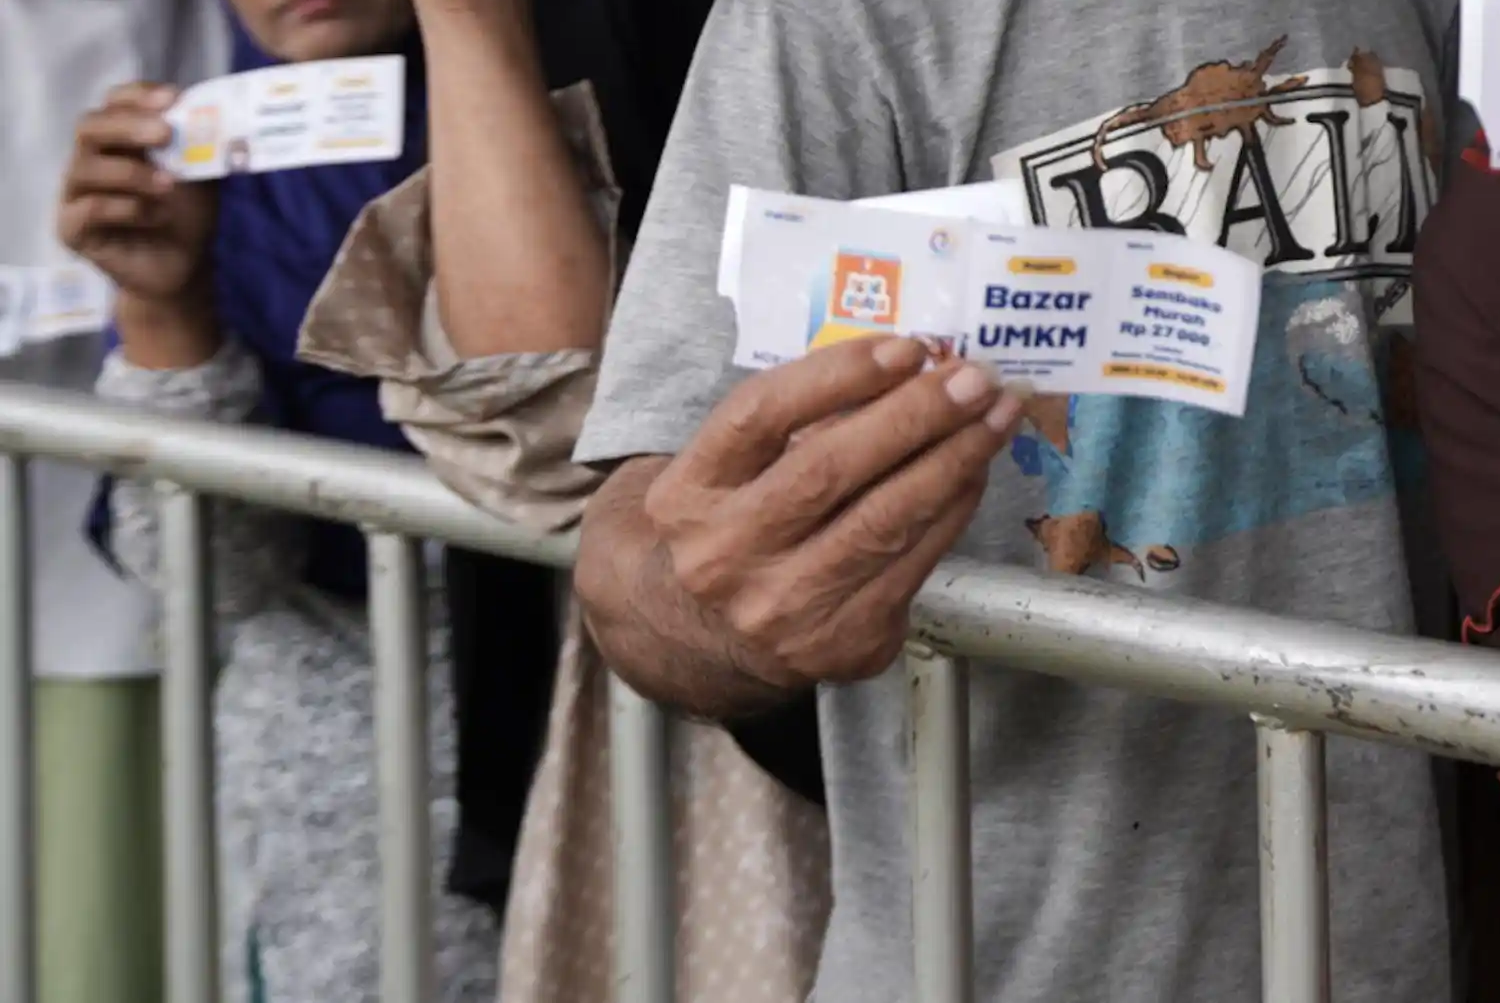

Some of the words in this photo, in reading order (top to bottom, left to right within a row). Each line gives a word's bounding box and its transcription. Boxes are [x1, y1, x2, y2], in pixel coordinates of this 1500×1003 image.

[984, 284, 1092, 311] Bazar
[978, 325, 1087, 348] UMKM
[1120, 321, 1146, 338] Rp
